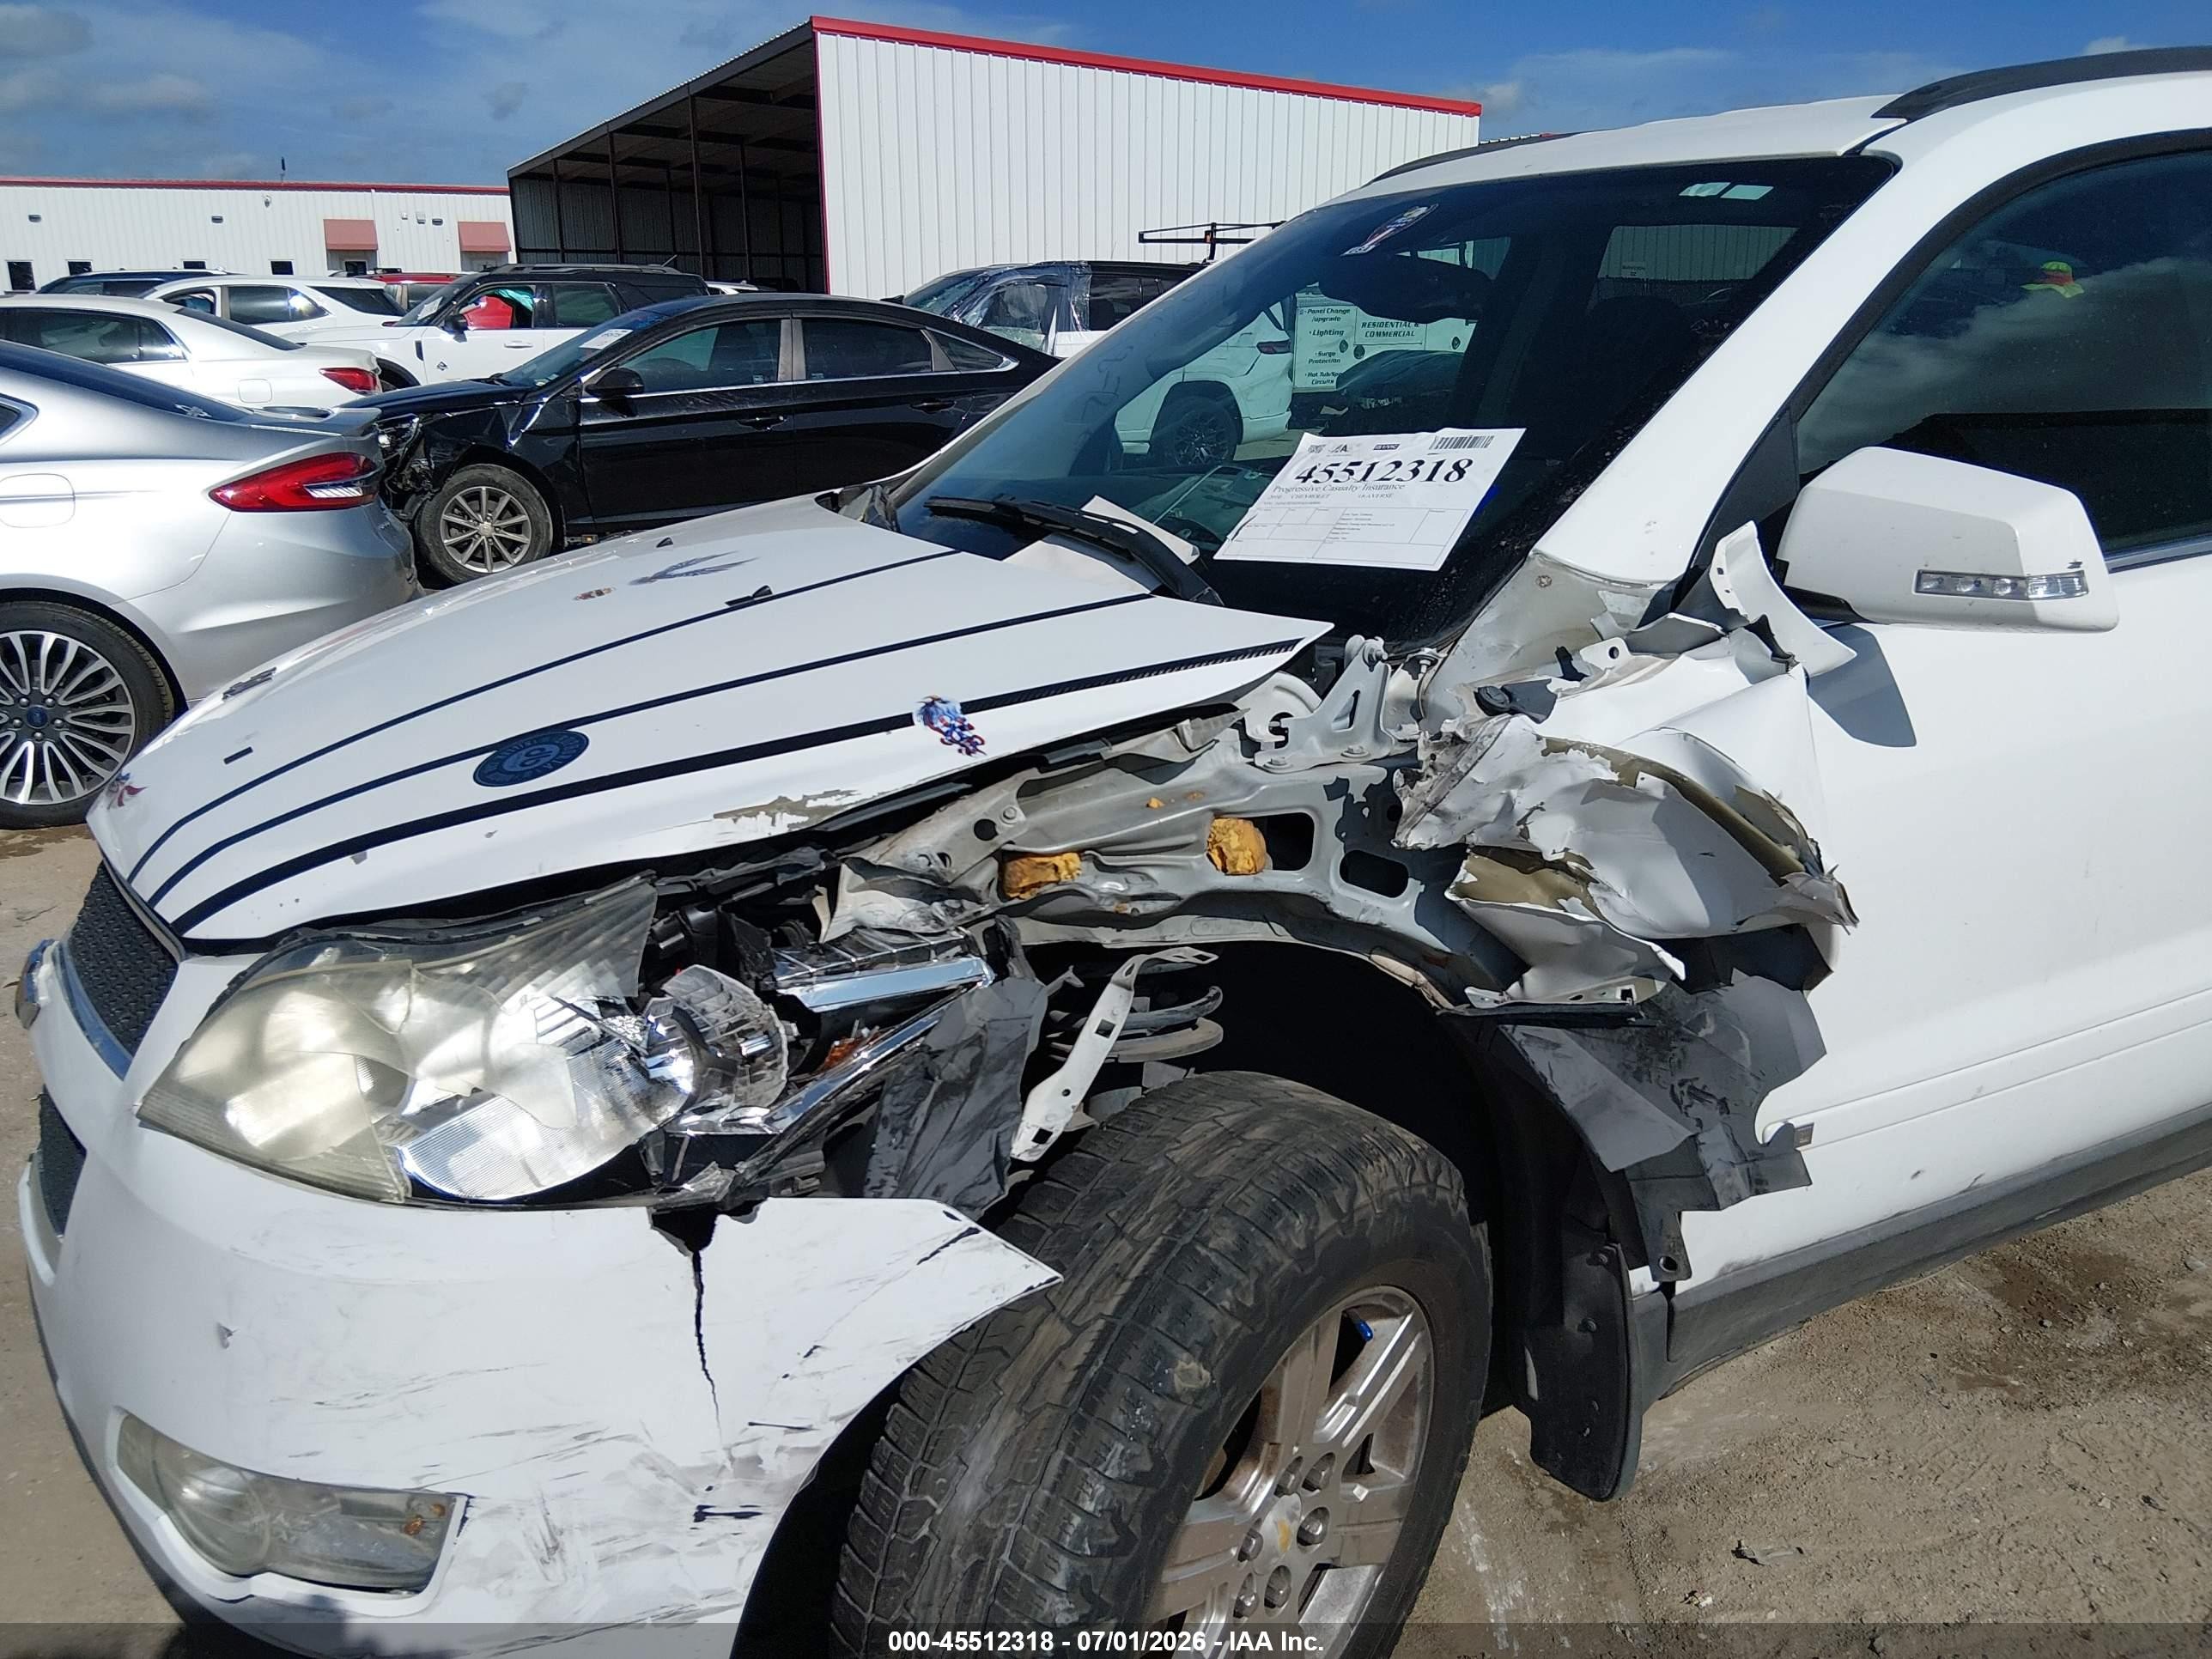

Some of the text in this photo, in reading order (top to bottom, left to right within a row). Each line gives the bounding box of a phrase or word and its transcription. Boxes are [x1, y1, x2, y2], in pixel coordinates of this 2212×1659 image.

[1295, 458, 1474, 484] 45512318
[1273, 483, 1406, 494] Progressive Casualty Insurance
